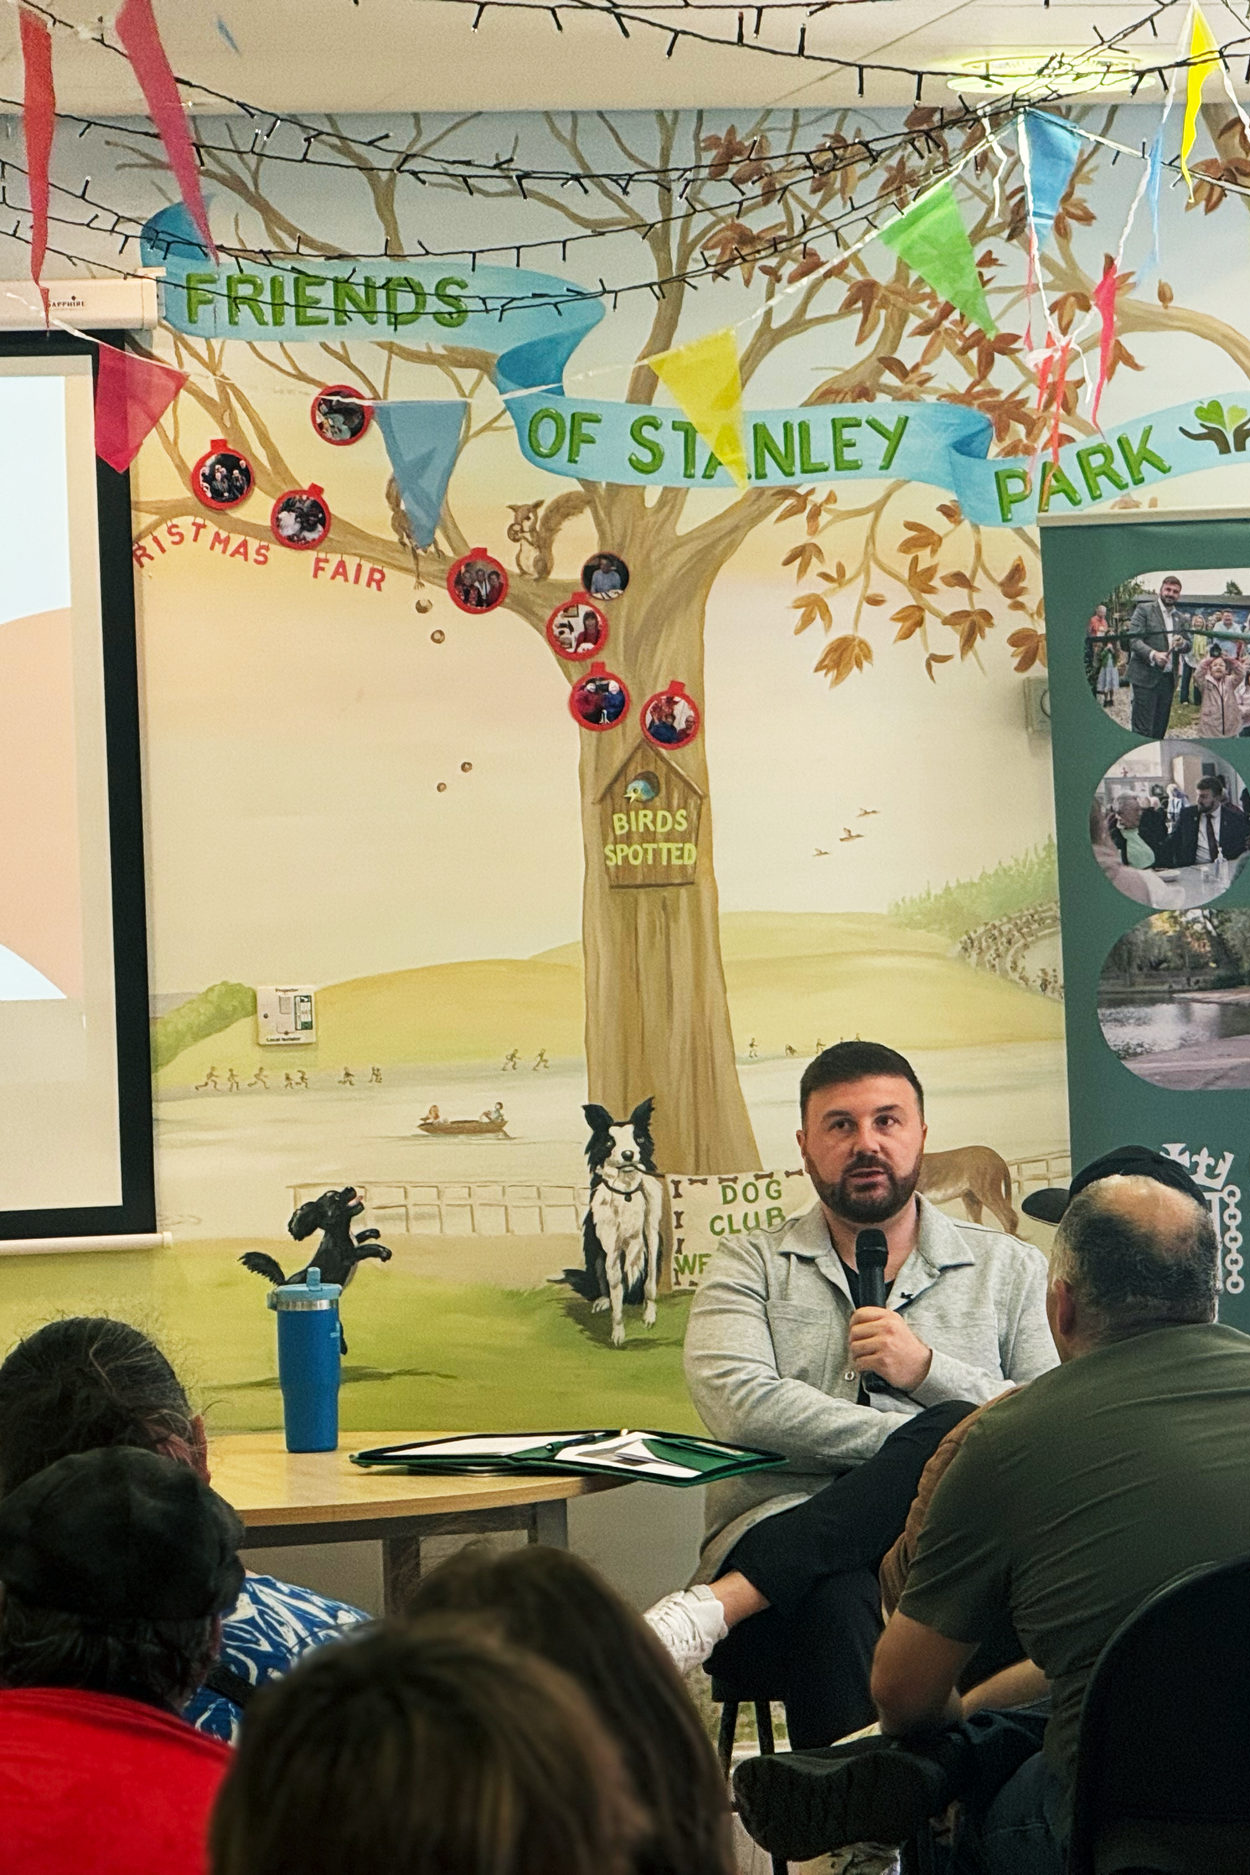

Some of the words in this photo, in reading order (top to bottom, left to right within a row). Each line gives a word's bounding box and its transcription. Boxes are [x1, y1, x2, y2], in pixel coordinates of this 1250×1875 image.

[185, 273, 470, 328] FRIENDS
[527, 407, 603, 464] OF
[993, 424, 1172, 524] PARK
[312, 555, 386, 592] FAIR
[612, 809, 689, 836] BIRDS
[604, 842, 697, 867] SPOTTED
[721, 1179, 782, 1205] DOG
[709, 1206, 786, 1236] CLUB
